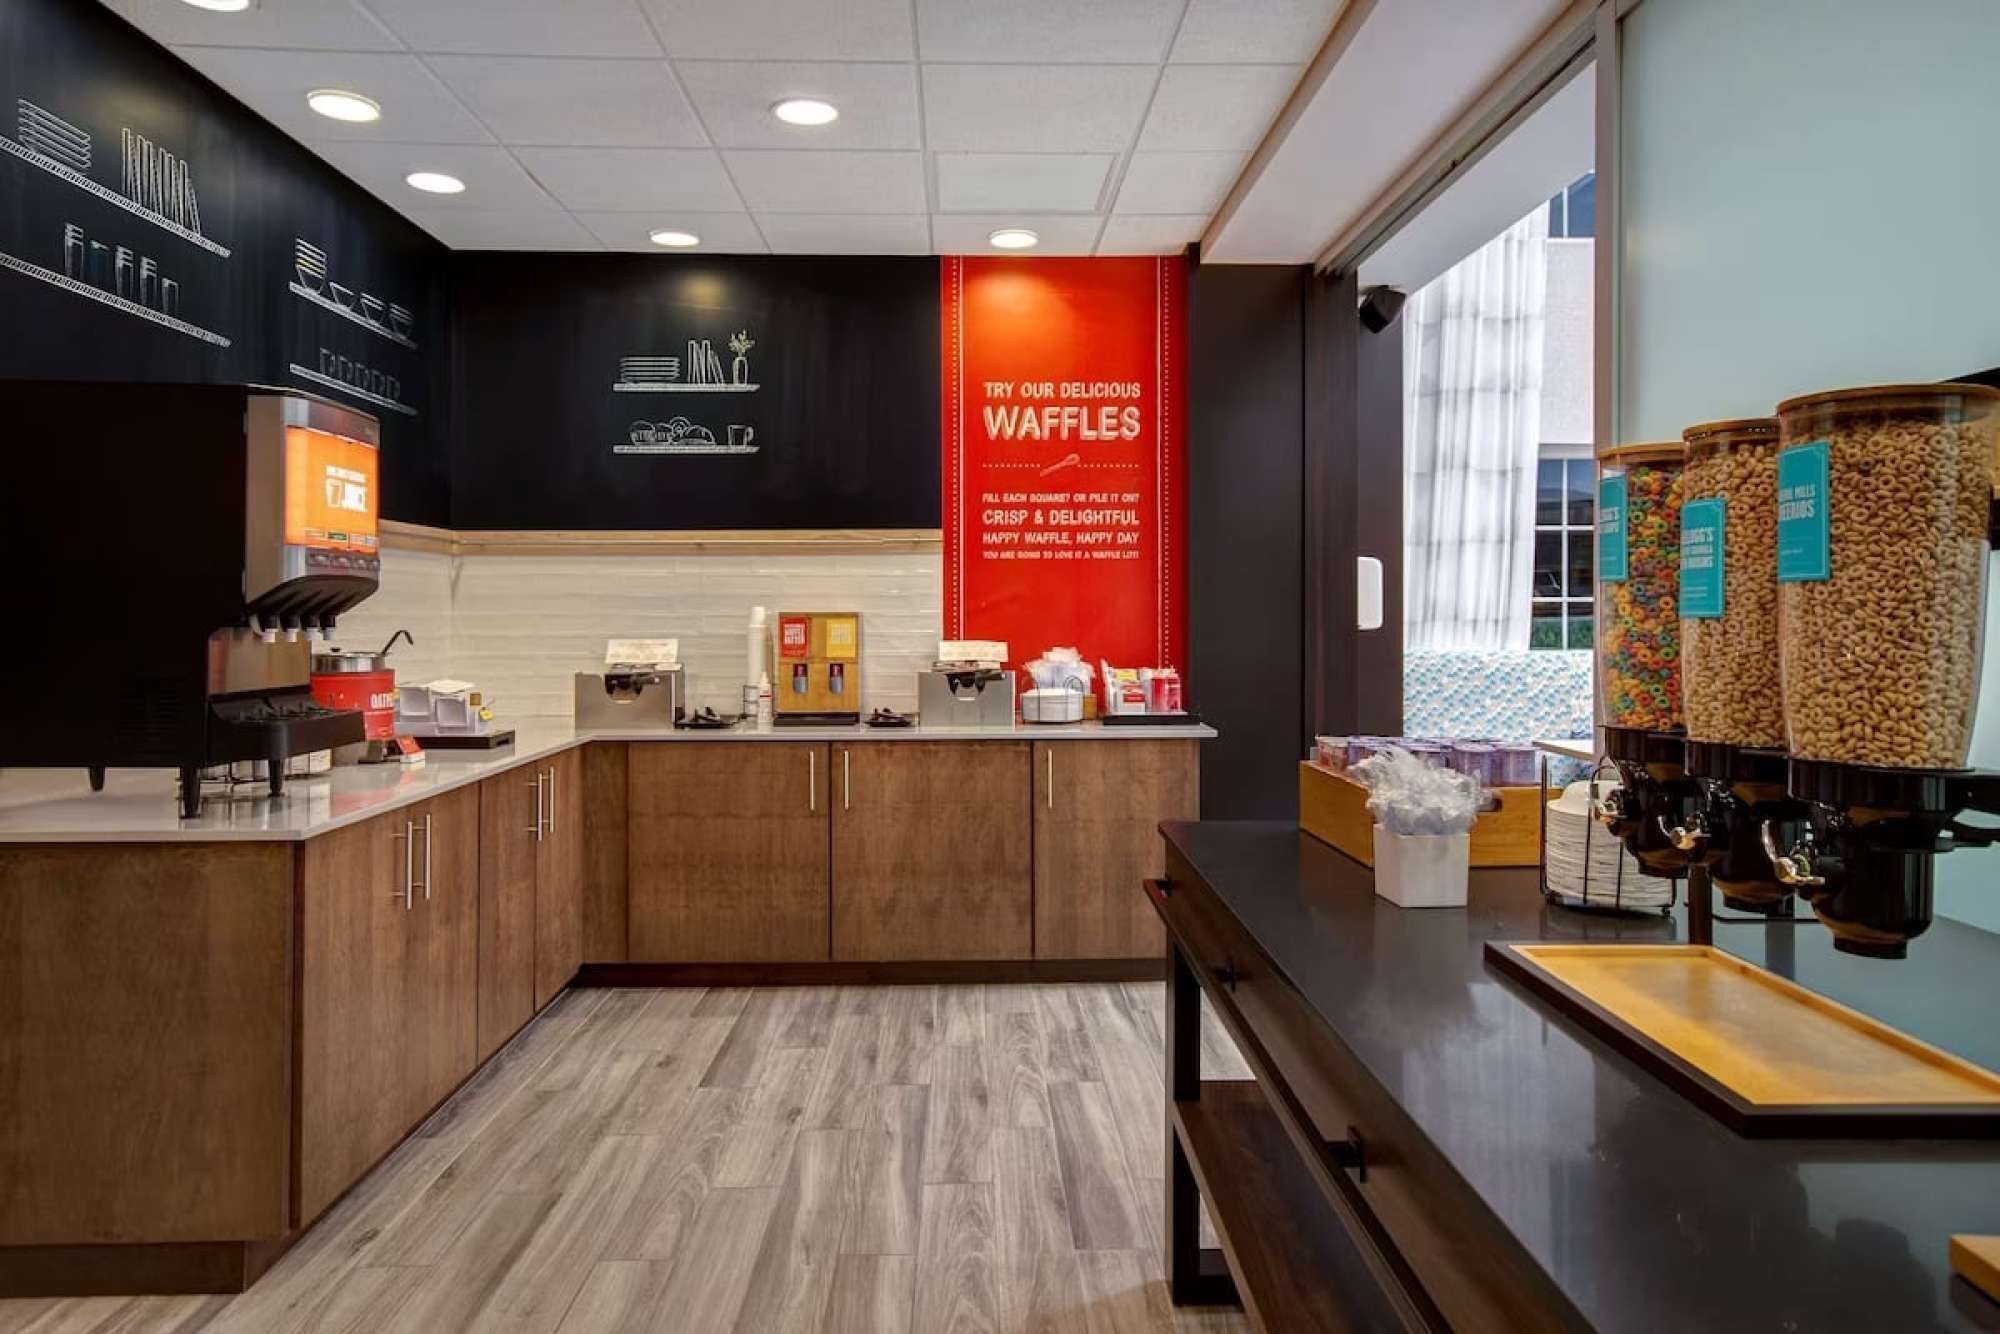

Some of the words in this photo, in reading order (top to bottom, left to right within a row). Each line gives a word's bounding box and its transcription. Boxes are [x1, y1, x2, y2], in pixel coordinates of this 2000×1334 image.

[984, 382, 1015, 398] TRY
[1020, 382, 1054, 398] OUR
[1059, 382, 1141, 398] DELICIOUS
[983, 405, 1141, 440] WAFFLES
[983, 493, 1000, 503] FILL
[1003, 493, 1027, 503] EACH
[1089, 493, 1108, 503] PILE
[1109, 493, 1119, 503] IT
[983, 509, 1028, 525] CRISP
[1034, 509, 1044, 525] &
[1050, 509, 1140, 525] DELIGHTFUL
[983, 532, 1020, 545] HAPPY
[1076, 532, 1113, 545] HAPPY
[1117, 532, 1140, 545] DAY
[983, 551, 999, 560] YOU
[1001, 551, 1016, 560] ARE
[1018, 551, 1041, 560] GOING
[1043, 551, 1053, 560] TO
[1055, 551, 1073, 560] LOVE
